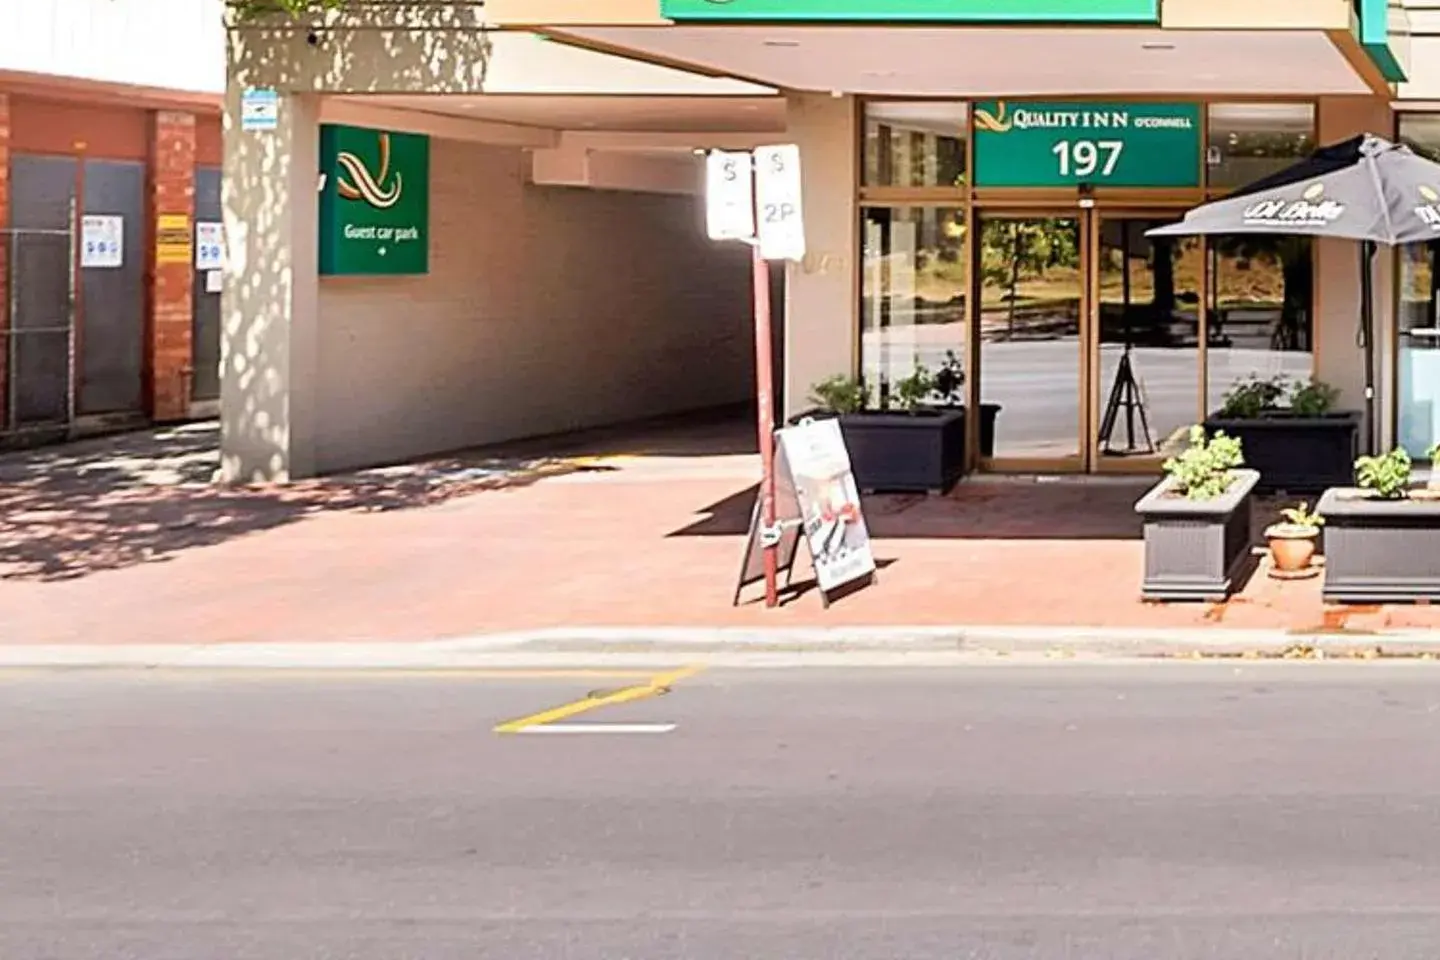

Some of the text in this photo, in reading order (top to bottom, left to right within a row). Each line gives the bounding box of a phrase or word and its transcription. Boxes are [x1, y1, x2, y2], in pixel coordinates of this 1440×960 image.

[1013, 109, 1079, 129] QUALITY
[1081, 111, 1129, 128] INN
[1052, 139, 1123, 176] 197
[763, 202, 797, 223] 2P
[344, 224, 419, 244] Guest car park
